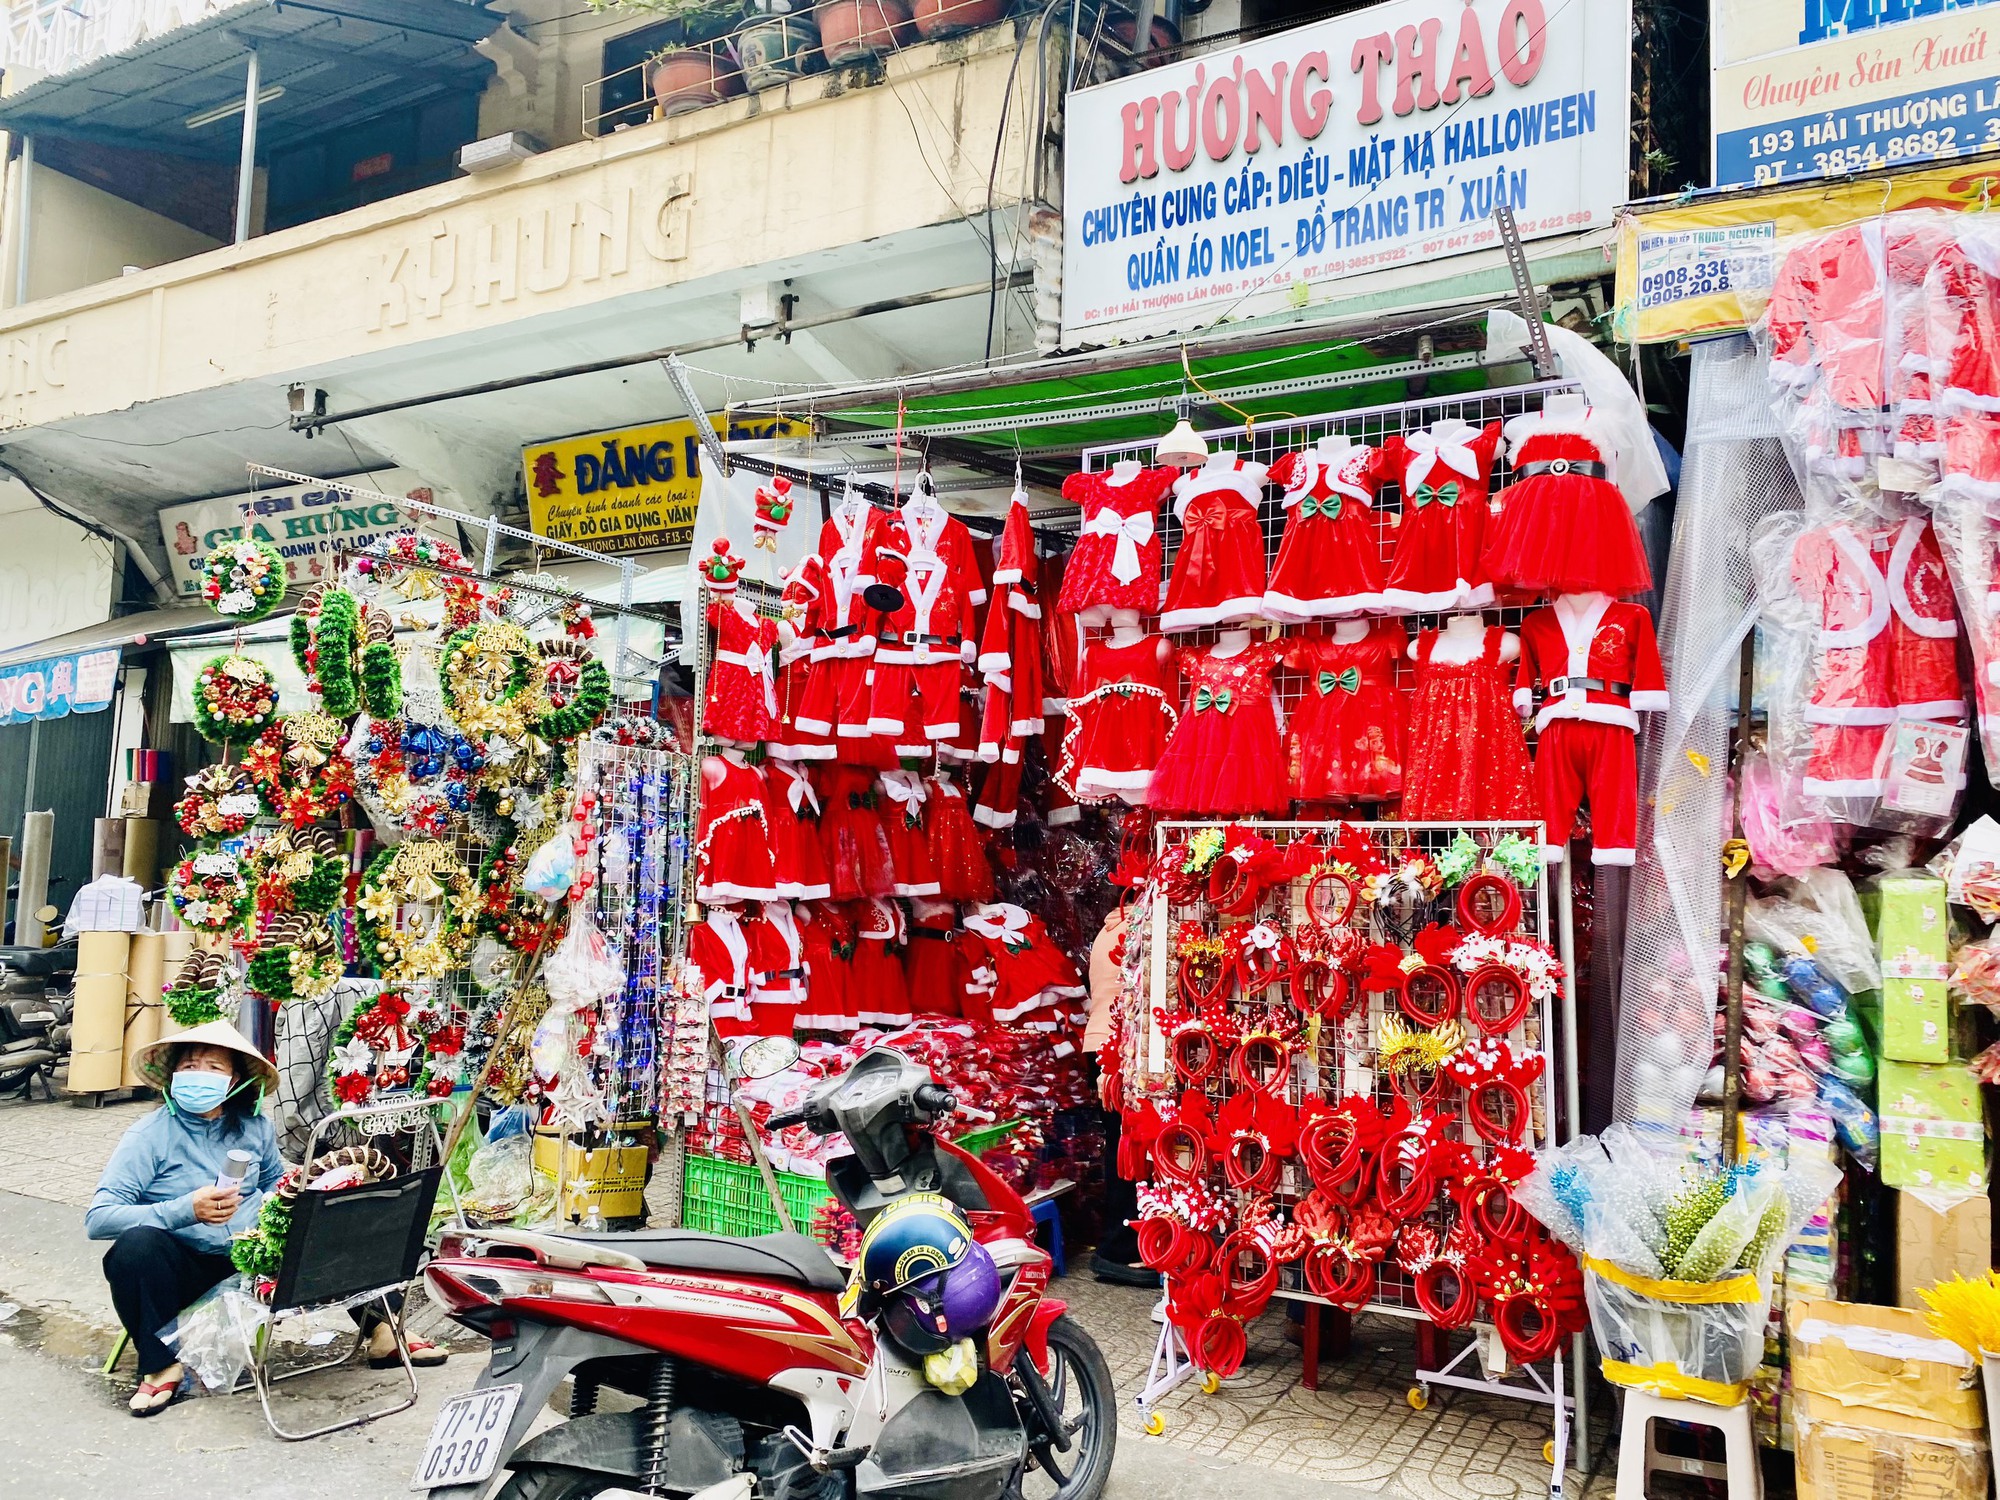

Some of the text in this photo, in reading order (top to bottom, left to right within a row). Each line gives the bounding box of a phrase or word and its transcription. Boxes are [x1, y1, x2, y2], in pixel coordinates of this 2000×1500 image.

[1119, 0, 1547, 184] HƯƠNG THẢO
[1743, 28, 1988, 110] Chuyên Sản Xuất
[1749, 130, 1794, 158] 193
[1804, 113, 1847, 148] HẢI
[1856, 94, 1967, 136] THƯỢNG
[1082, 192, 1156, 247] CHUYÊN
[1162, 182, 1216, 229] CUNG
[1224, 157, 1272, 215] CẤP:
[1278, 147, 1329, 204] DIỀU
[1349, 134, 1395, 191] MẶT
[1404, 131, 1435, 180] NẠ
[1444, 90, 1596, 166] HALLOWEEN
[473, 172, 693, 308] HƯNG
[1127, 235, 1179, 292] QUẦN
[1187, 233, 1213, 279] ÁO
[1221, 226, 1275, 273] NOEL
[1296, 200, 1326, 257] ĐỒ
[1332, 195, 1408, 250] TRANG
[1459, 165, 1527, 223] XUÂN
[1692, 231, 1725, 244] TRUNG
[1729, 225, 1772, 240] NGUYÊN
[1084, 309, 1101, 320] ĐC:
[1104, 304, 1119, 317] 191
[1122, 299, 1139, 313] HẢI
[1142, 292, 1185, 309] THƯỢNG
[1187, 286, 1207, 300] LÃN
[1211, 281, 1233, 297] ÔNG
[1242, 276, 1264, 291] P.13
[1273, 270, 1291, 285] Q.5
[1447, 235, 1469, 249] 847
[1473, 228, 1495, 244] 299
[1540, 215, 1564, 230] 422
[574, 440, 675, 495] ĐĂNG
[204, 502, 400, 551] GIA HƯNG
[548, 504, 582, 522] Chuyên
[585, 499, 607, 514] kinh
[611, 494, 641, 510] doanh
[645, 494, 662, 505] các
[667, 489, 688, 504] loại
[580, 515, 597, 535] ĐỒ
[600, 517, 622, 532] GIA
[625, 511, 661, 532] DỤNG
[276, 541, 316, 559] OANH
[638, 533, 660, 548] ÔNG
[440, 1394, 506, 1440] 77-Y3
[424, 1437, 489, 1482] 0338
